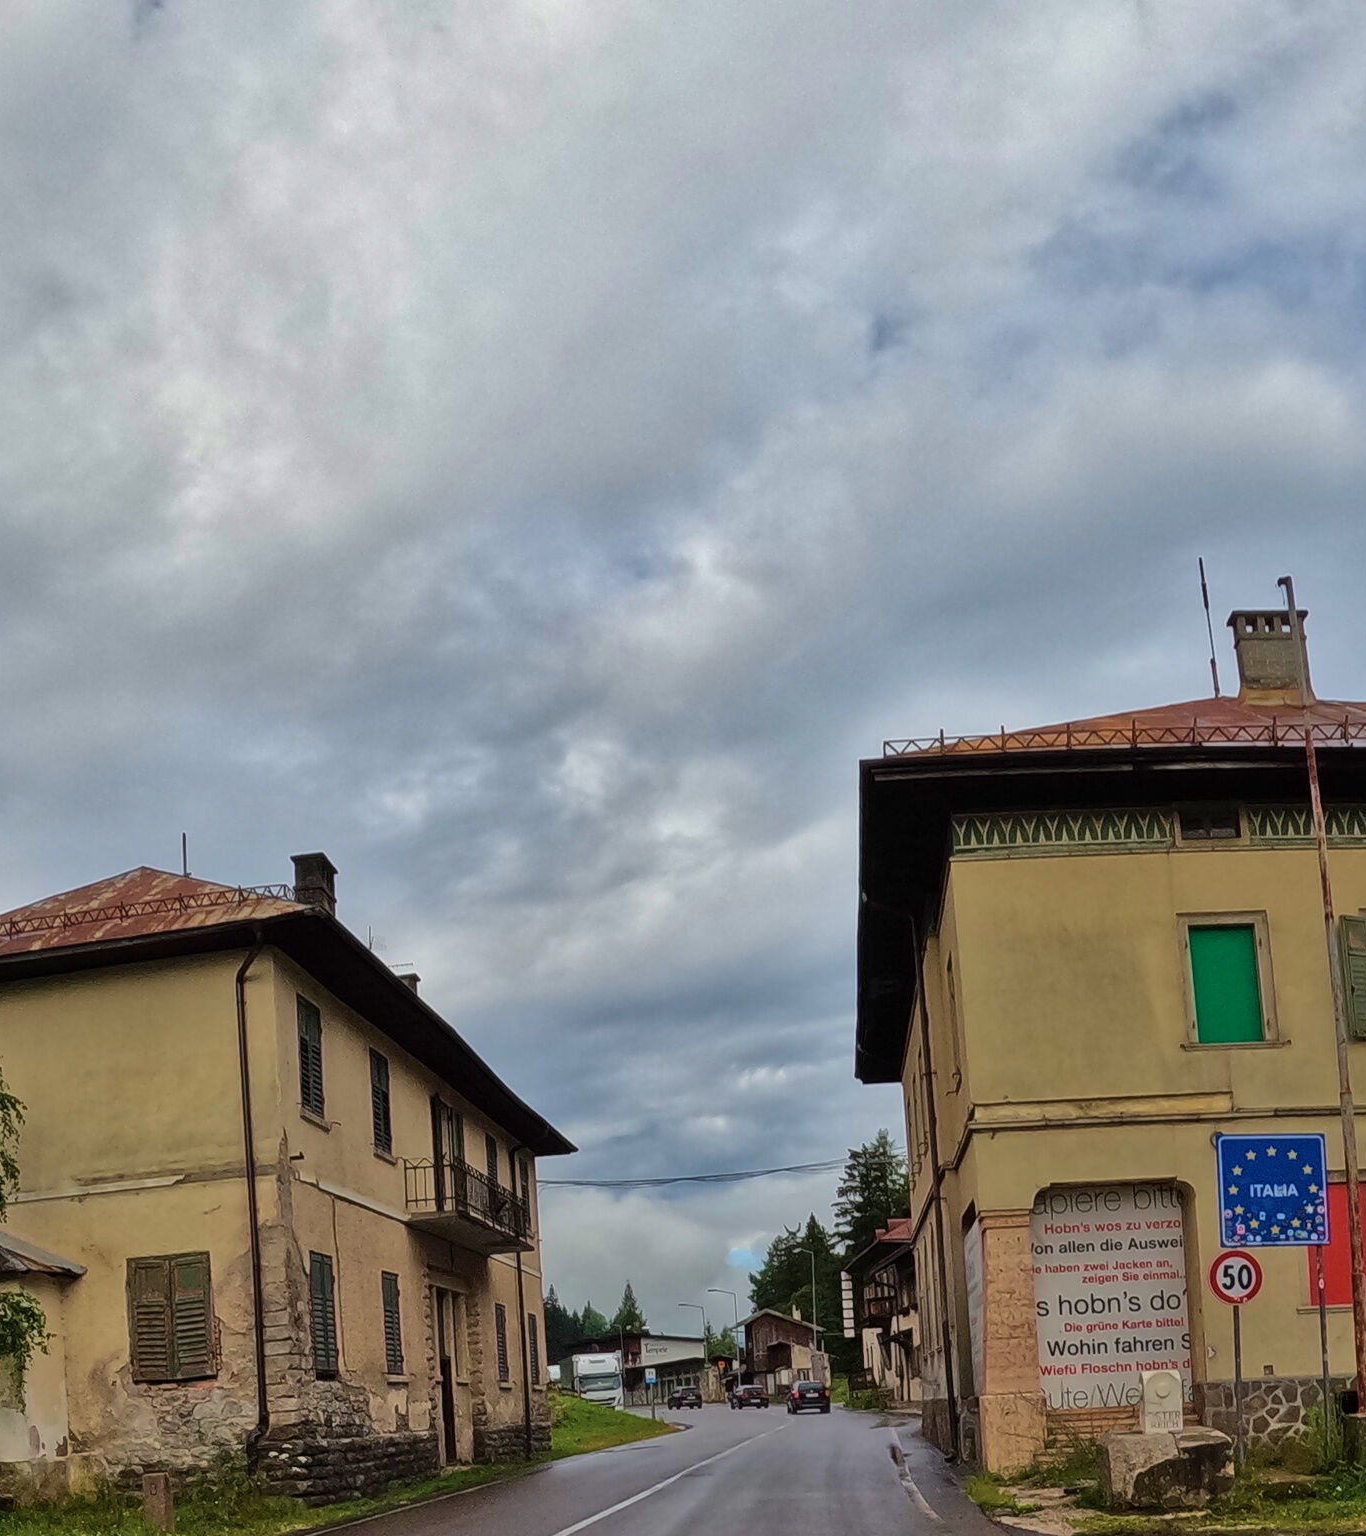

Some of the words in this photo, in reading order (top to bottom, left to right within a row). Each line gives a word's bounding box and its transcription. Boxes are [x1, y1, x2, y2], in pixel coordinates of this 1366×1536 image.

[1249, 1183, 1299, 1198] ITALIA
[1044, 1221, 1090, 1234] Hobn's
[1094, 1222, 1122, 1232] wos
[1125, 1221, 1141, 1230] zu
[1145, 1219, 1181, 1230] verzo
[1059, 1240, 1095, 1254] allen
[1100, 1238, 1123, 1251] die
[1128, 1234, 1183, 1250] Auswei
[1045, 1263, 1080, 1273] haben
[1084, 1261, 1109, 1271] zwei
[1112, 1259, 1152, 1270] Jacken
[1156, 1259, 1173, 1269] an,
[1082, 1273, 1119, 1285] zeigen
[1122, 1271, 1139, 1281] Sie
[1222, 1264, 1252, 1290] 50
[1064, 1322, 1082, 1332] Die
[1086, 1321, 1118, 1334] grüne
[1122, 1319, 1152, 1330] Karte
[1156, 1317, 1184, 1328] bitte!
[1047, 1339, 1108, 1357] Wohin
[1114, 1336, 1174, 1354] fahren
[1040, 1366, 1076, 1377] Wiefü
[1081, 1361, 1132, 1375] Floschn
[1136, 1359, 1178, 1371] hobn's
